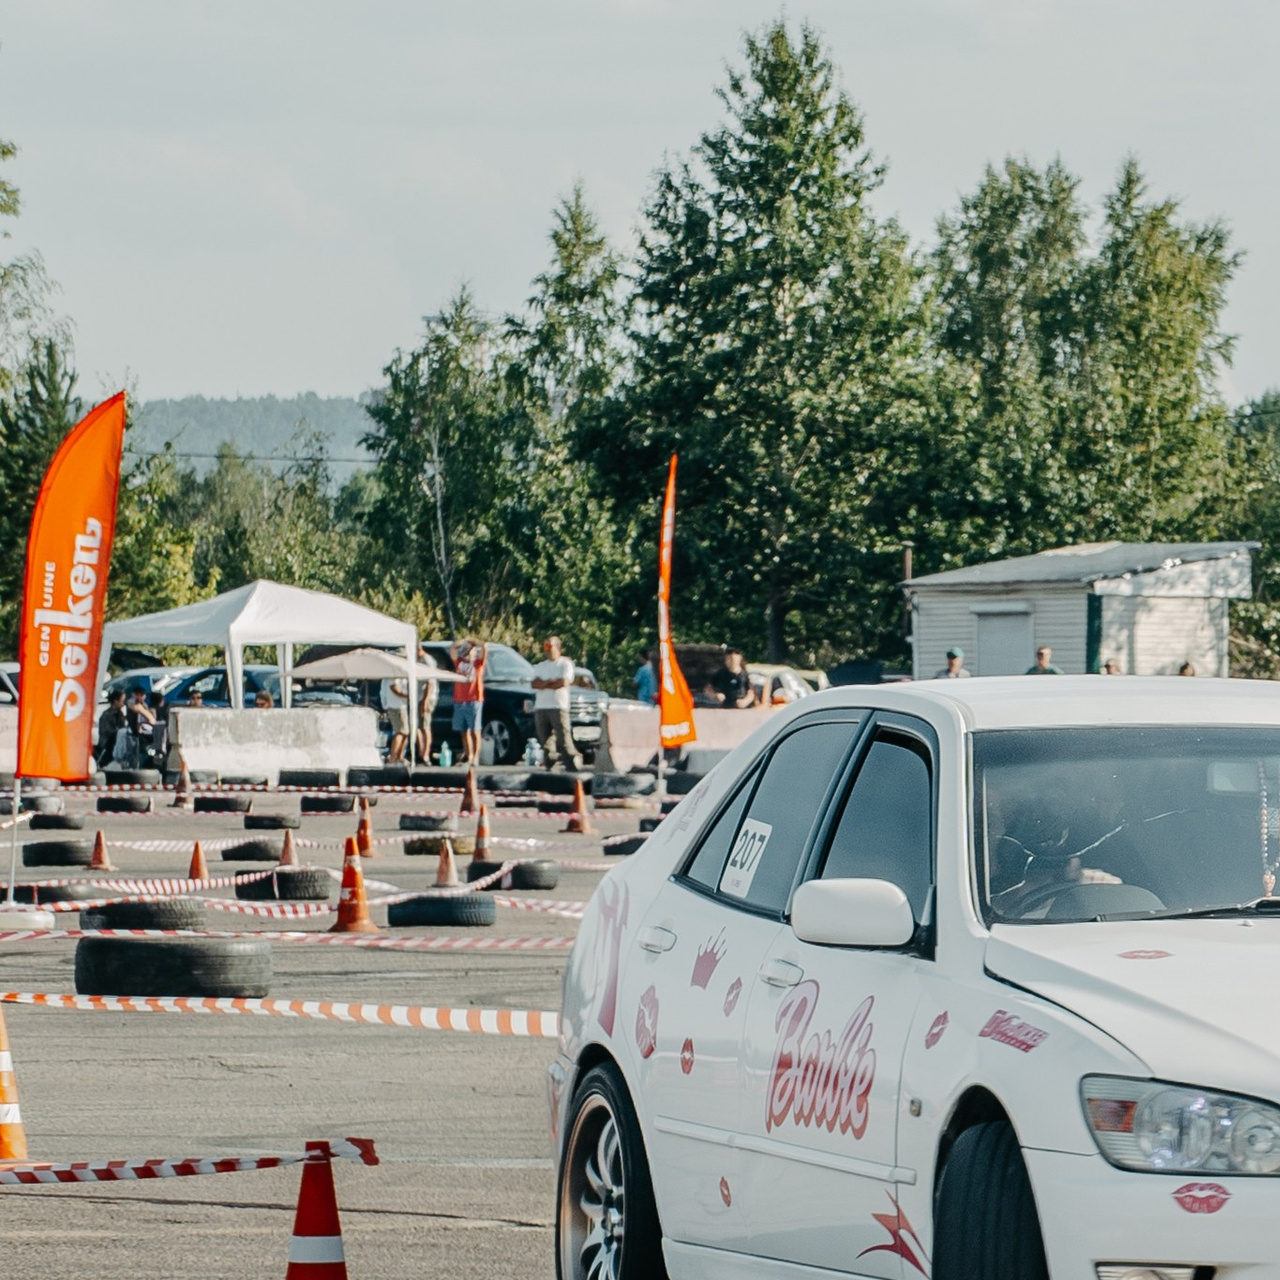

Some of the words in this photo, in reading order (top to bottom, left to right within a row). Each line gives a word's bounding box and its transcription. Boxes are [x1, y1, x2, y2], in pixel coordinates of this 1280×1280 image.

[35, 517, 102, 722] Seiken
[730, 828, 767, 872] 207
[765, 979, 876, 1140] Barbie
